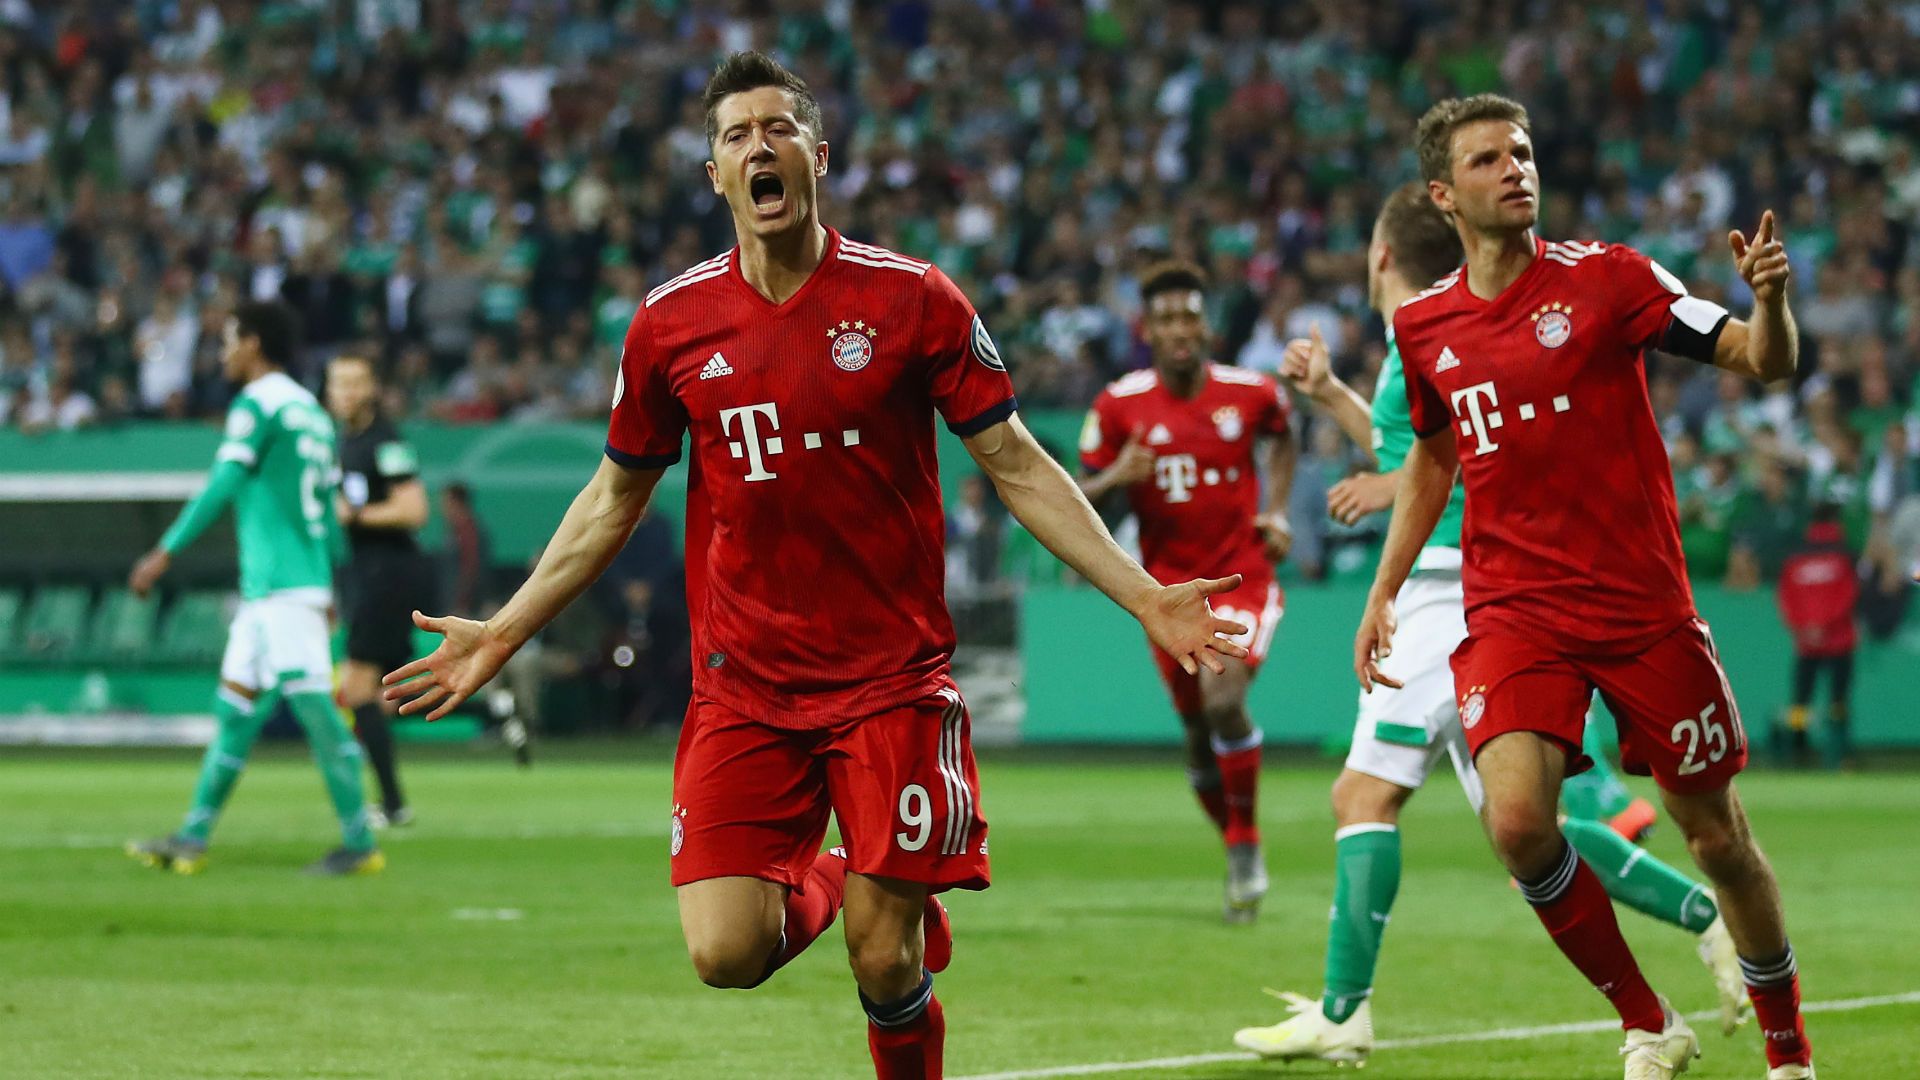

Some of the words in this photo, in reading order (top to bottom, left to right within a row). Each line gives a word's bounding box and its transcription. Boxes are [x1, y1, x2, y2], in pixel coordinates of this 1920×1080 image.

[842, 335, 868, 349] BAYERN
[699, 366, 734, 380] adidas
[1671, 702, 1728, 776] 25
[896, 784, 932, 851] 9
